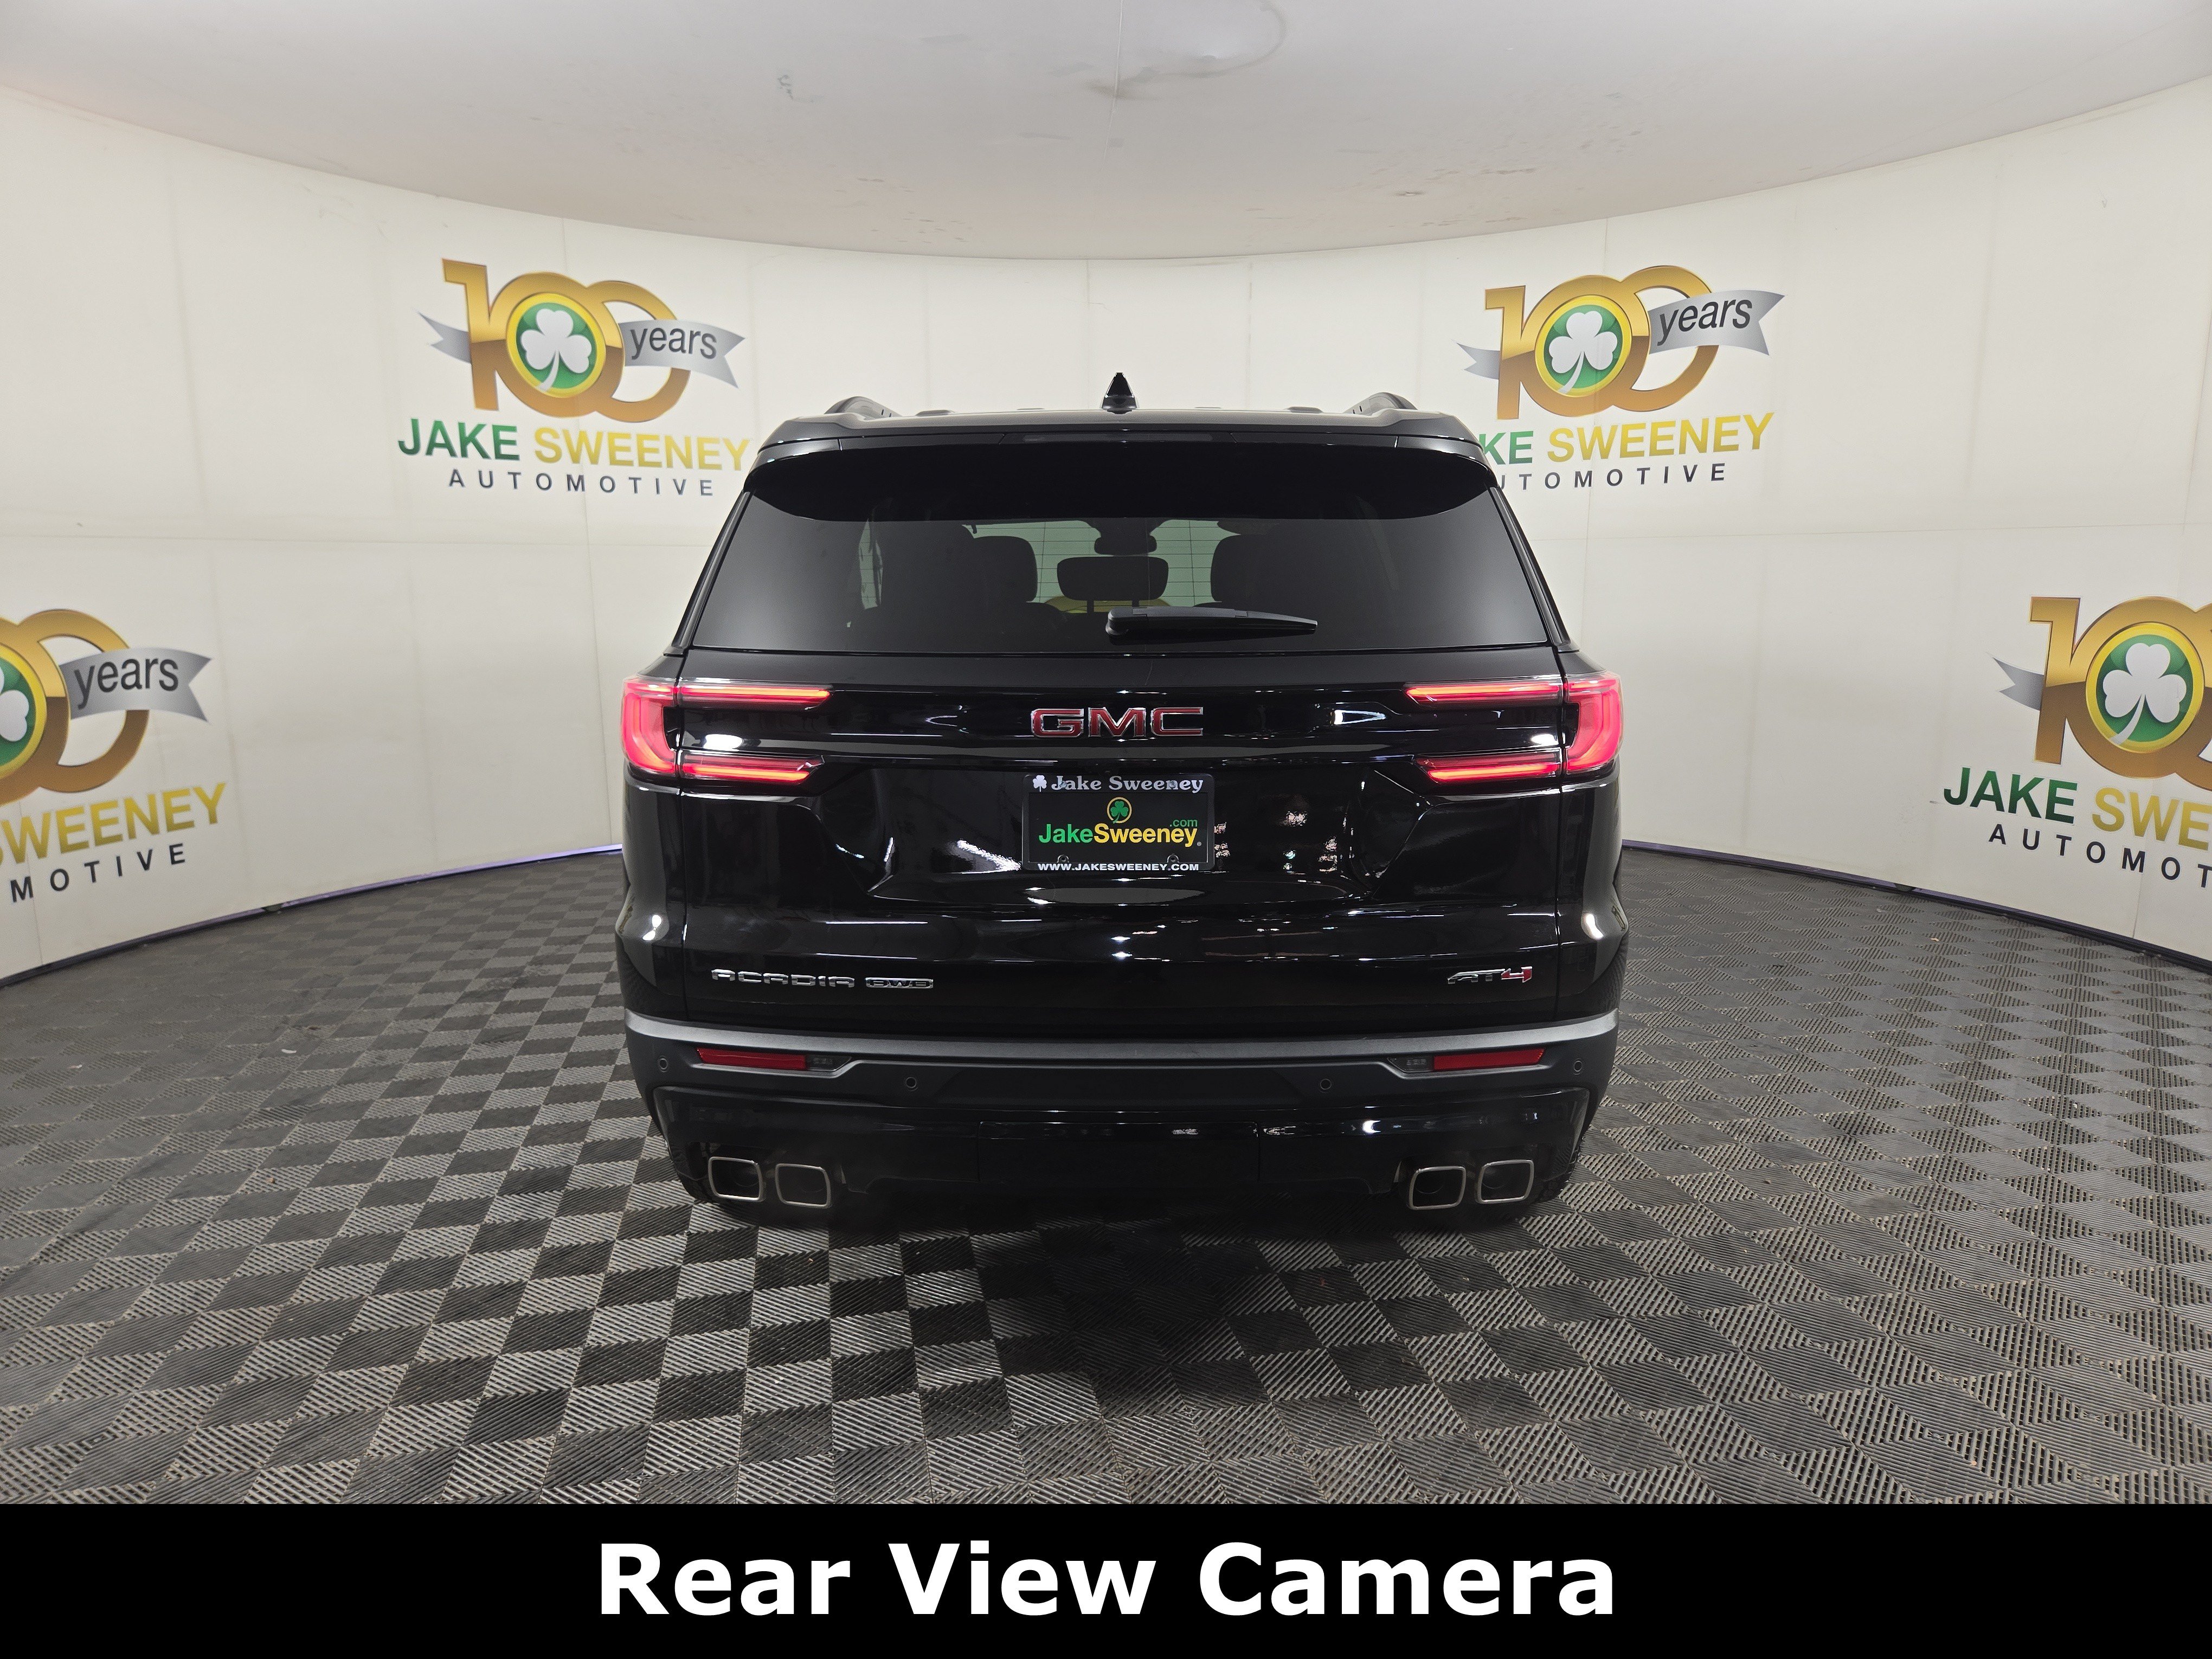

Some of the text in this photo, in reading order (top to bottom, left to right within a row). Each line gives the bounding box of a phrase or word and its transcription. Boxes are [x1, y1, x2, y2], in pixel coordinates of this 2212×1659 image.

[629, 327, 718, 361] years
[1656, 299, 1753, 346] years
[397, 418, 750, 471] JAKE SWEENEY
[1547, 412, 1774, 463] SWEENEY
[448, 468, 713, 497] AUTOMOTIVE
[74, 658, 179, 709] years
[1031, 706, 1204, 738] GMC
[1051, 775, 1204, 794] Jake Sweeney
[0, 783, 226, 866] WEENEY
[1943, 767, 2212, 851] JAKE SWE
[9, 843, 186, 903] MOTIVE
[1037, 863, 1199, 871] WWW.JAKESWEENEY.COM
[1988, 824, 2212, 888] AUTOMOT
[711, 968, 856, 988] ACADIA
[1447, 966, 1533, 985] AT4
